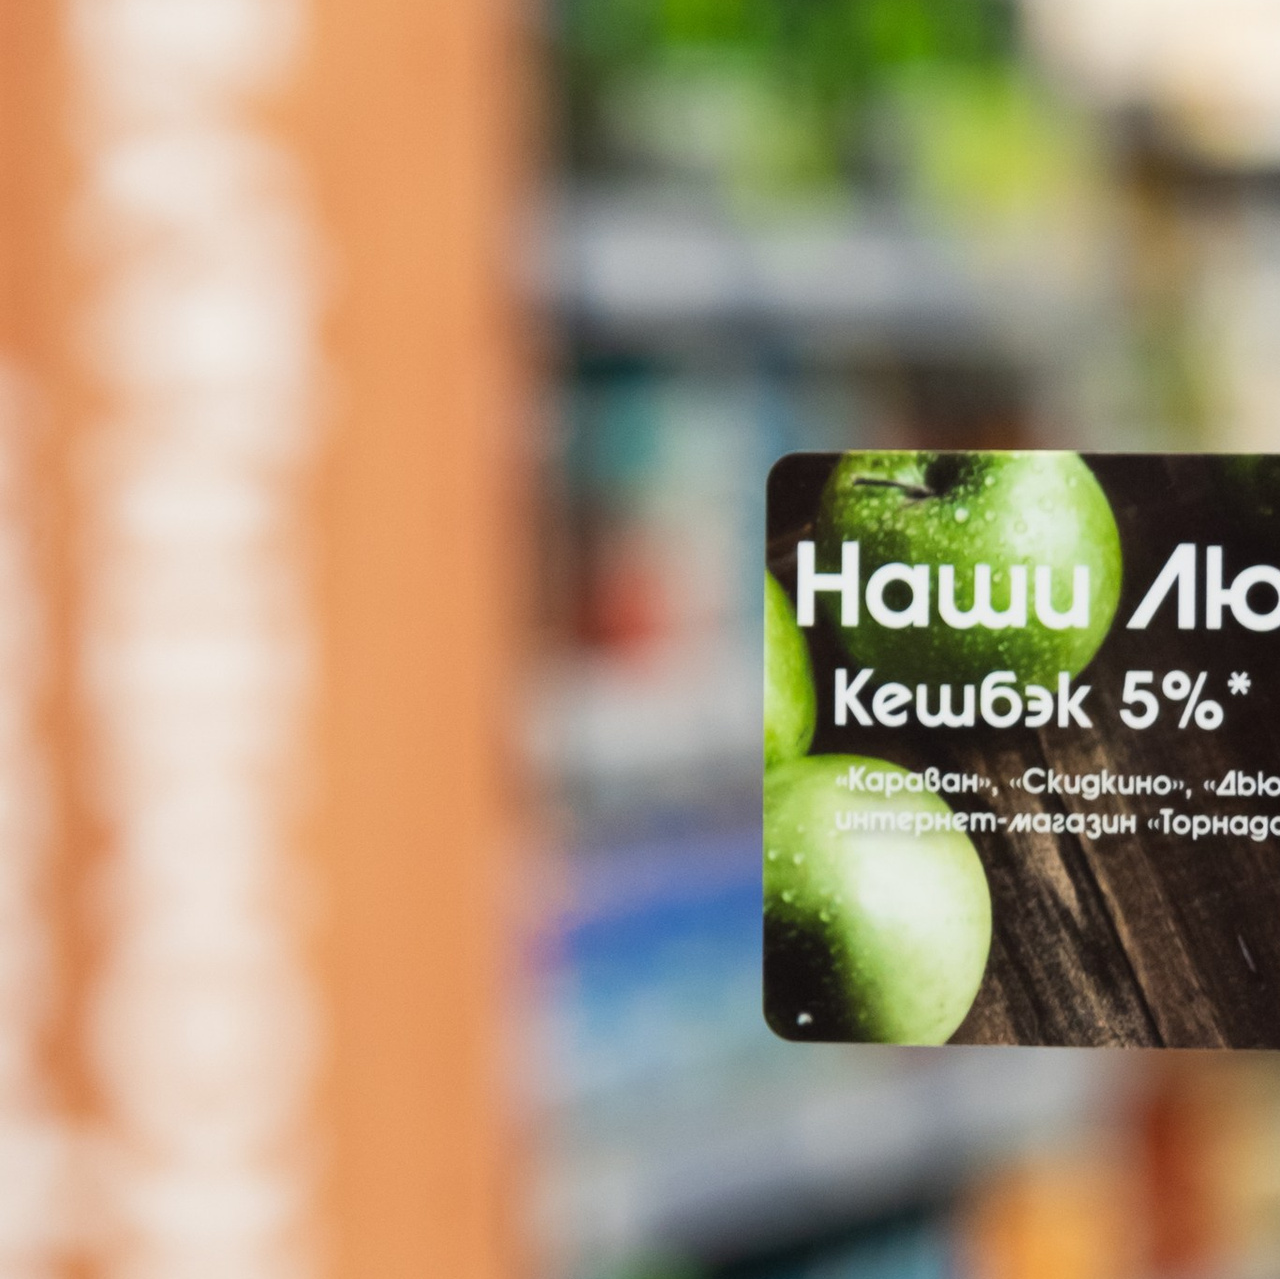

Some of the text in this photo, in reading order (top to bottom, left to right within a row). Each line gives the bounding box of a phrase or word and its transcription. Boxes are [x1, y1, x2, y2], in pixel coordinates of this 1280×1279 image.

[796, 539, 1091, 629] Наши
[833, 667, 1093, 729] Кешбэк
[835, 766, 999, 798] «Караван»,
[1009, 766, 1192, 801] «Скидкино»,
[835, 811, 1137, 840] интернет-магазин
